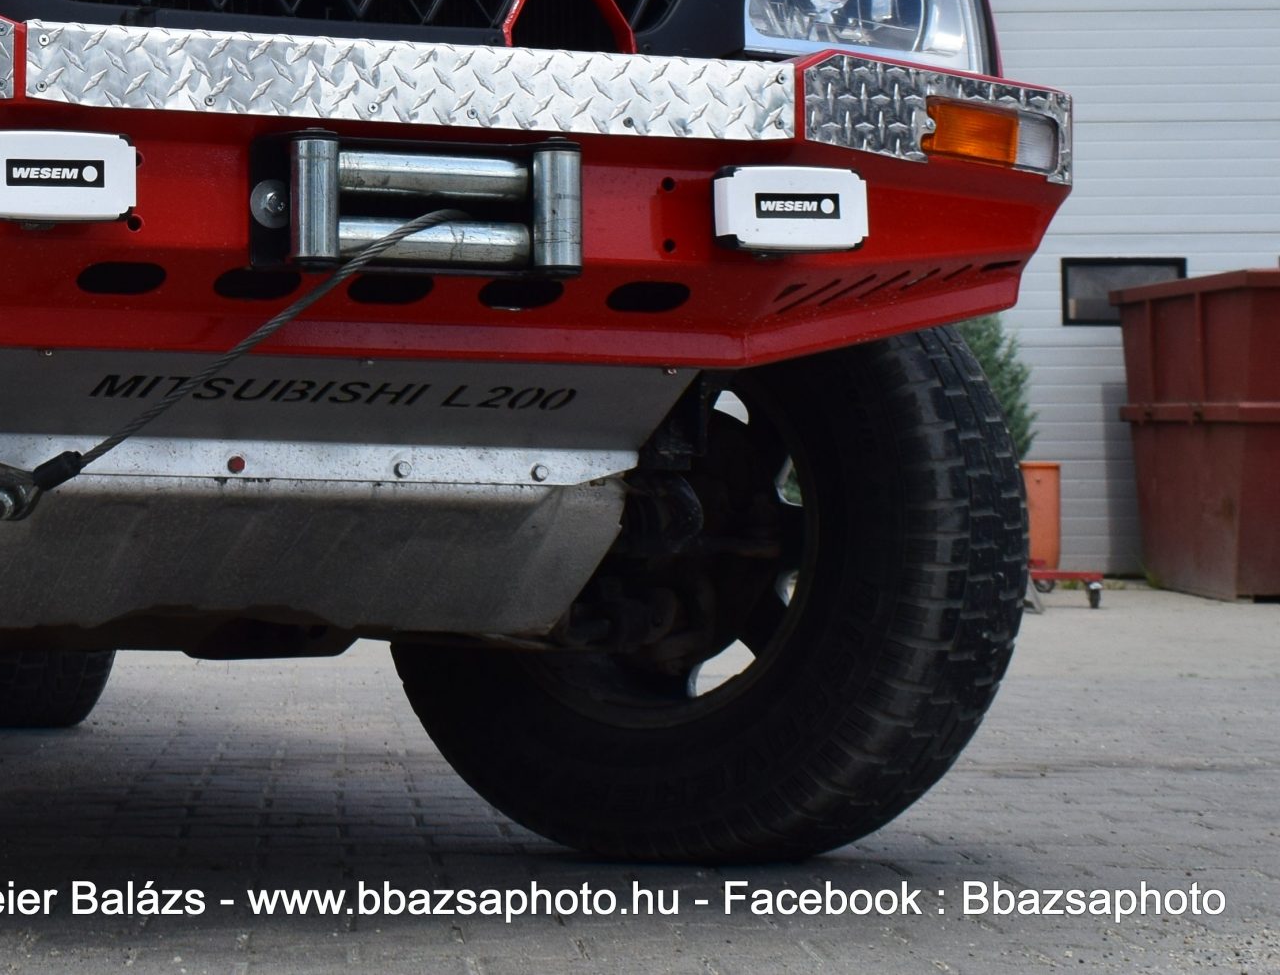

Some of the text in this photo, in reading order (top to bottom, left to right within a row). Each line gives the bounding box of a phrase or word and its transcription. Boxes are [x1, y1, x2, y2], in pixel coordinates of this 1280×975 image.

[12, 167, 79, 179] WESEM
[760, 200, 818, 212] WESEM
[89, 374, 579, 411] MITSUBISHI L200
